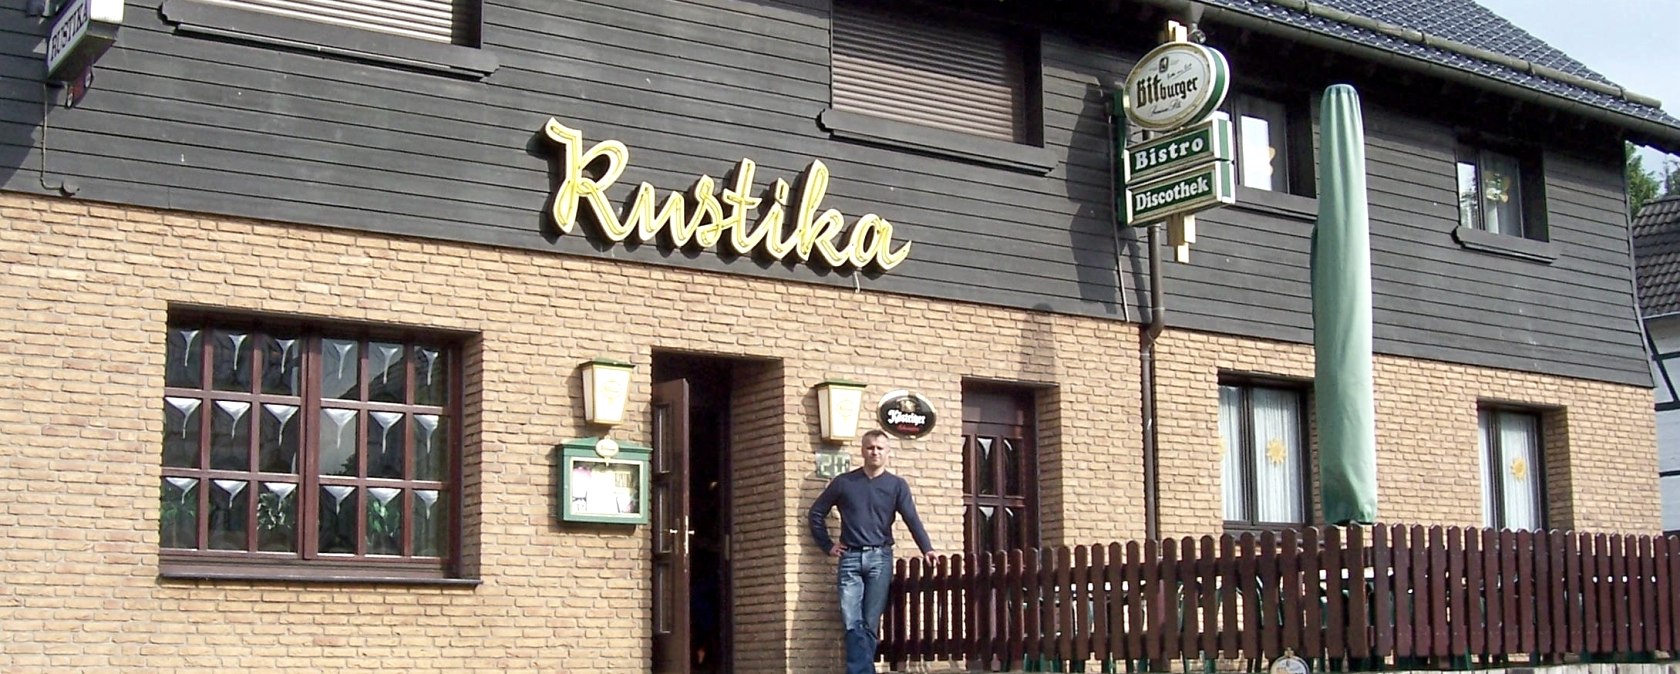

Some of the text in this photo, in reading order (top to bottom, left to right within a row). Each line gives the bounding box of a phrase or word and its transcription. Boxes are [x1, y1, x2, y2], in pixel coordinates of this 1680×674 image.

[50, 3, 88, 61] RUSTIKA
[1136, 74, 1198, 109] Bitburger
[1135, 138, 1204, 170] Bistro
[545, 117, 911, 270] Rustika
[1135, 176, 1209, 211] Discothek
